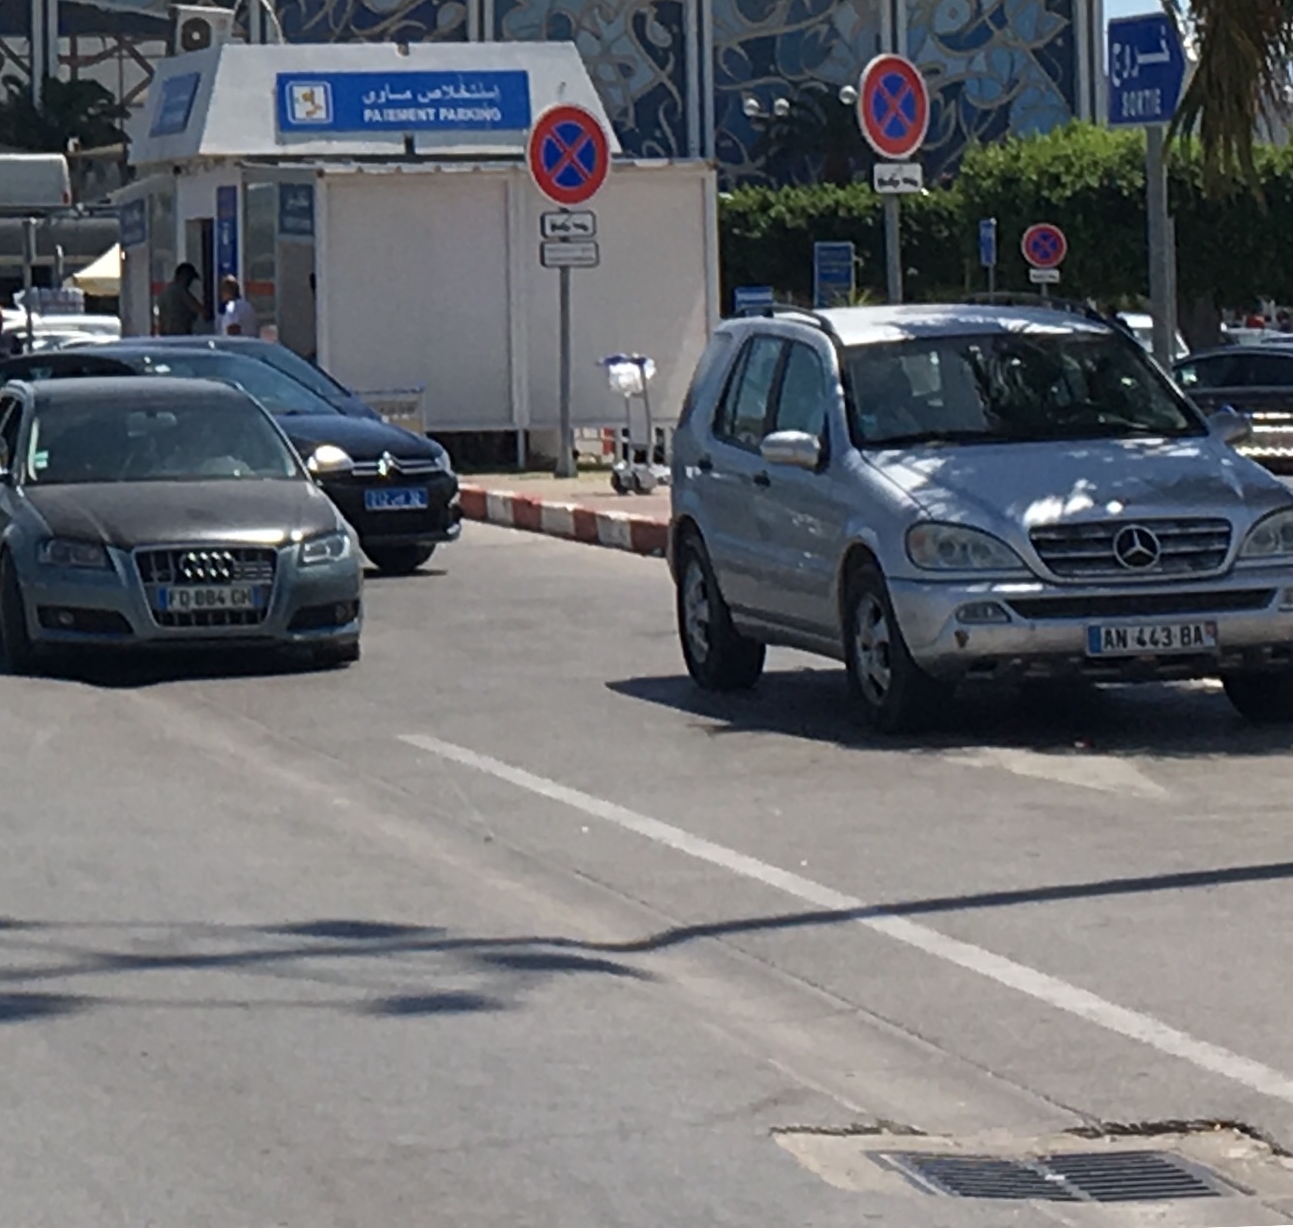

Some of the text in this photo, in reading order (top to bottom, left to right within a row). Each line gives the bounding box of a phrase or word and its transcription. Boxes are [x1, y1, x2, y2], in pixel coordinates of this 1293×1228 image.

[1121, 88, 1162, 118] SORTIE
[362, 107, 502, 122] PAIEMENT PARKING
